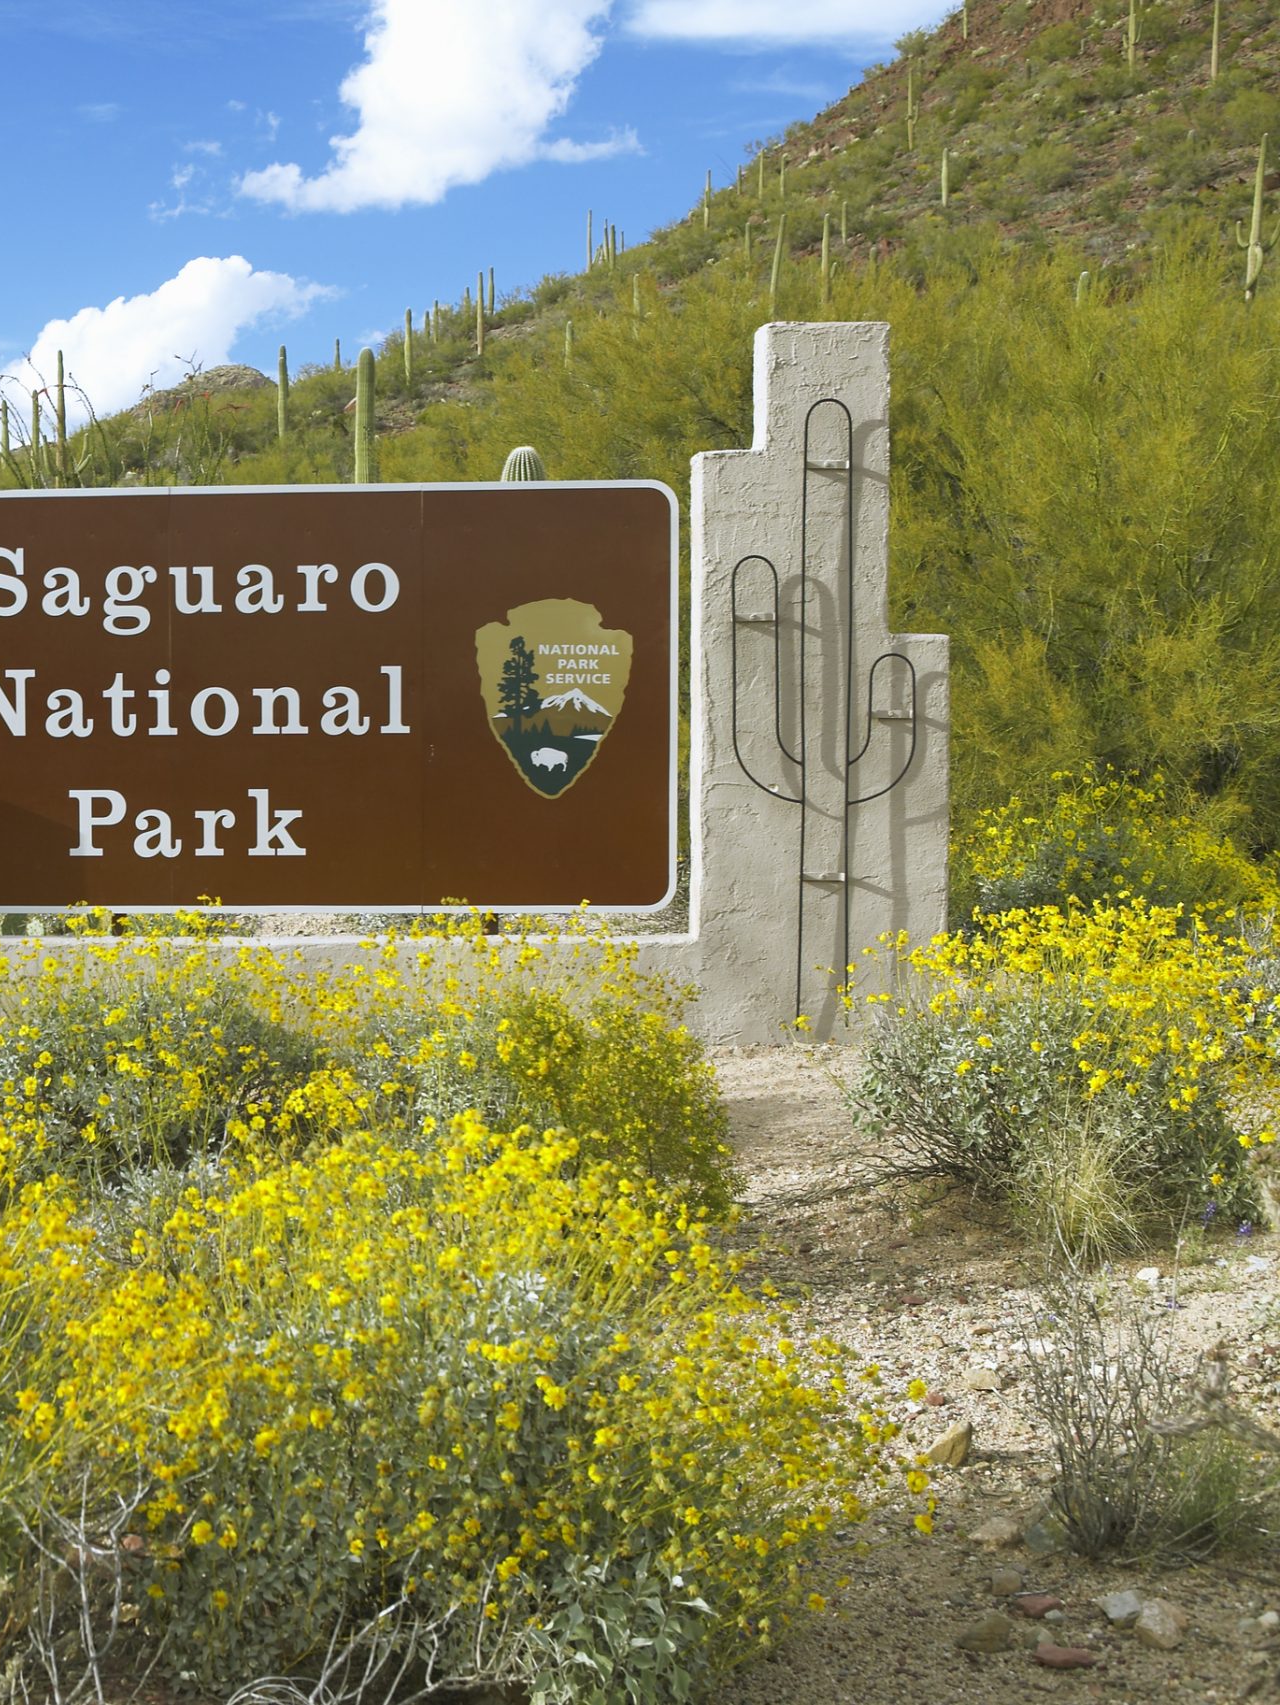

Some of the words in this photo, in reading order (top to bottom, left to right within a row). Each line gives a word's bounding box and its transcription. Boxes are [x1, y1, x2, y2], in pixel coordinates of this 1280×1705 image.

[538, 644, 620, 655] NATIONAL
[557, 659, 599, 669] PARK
[545, 673, 611, 684] SERVICE
[68, 788, 307, 858] Park
